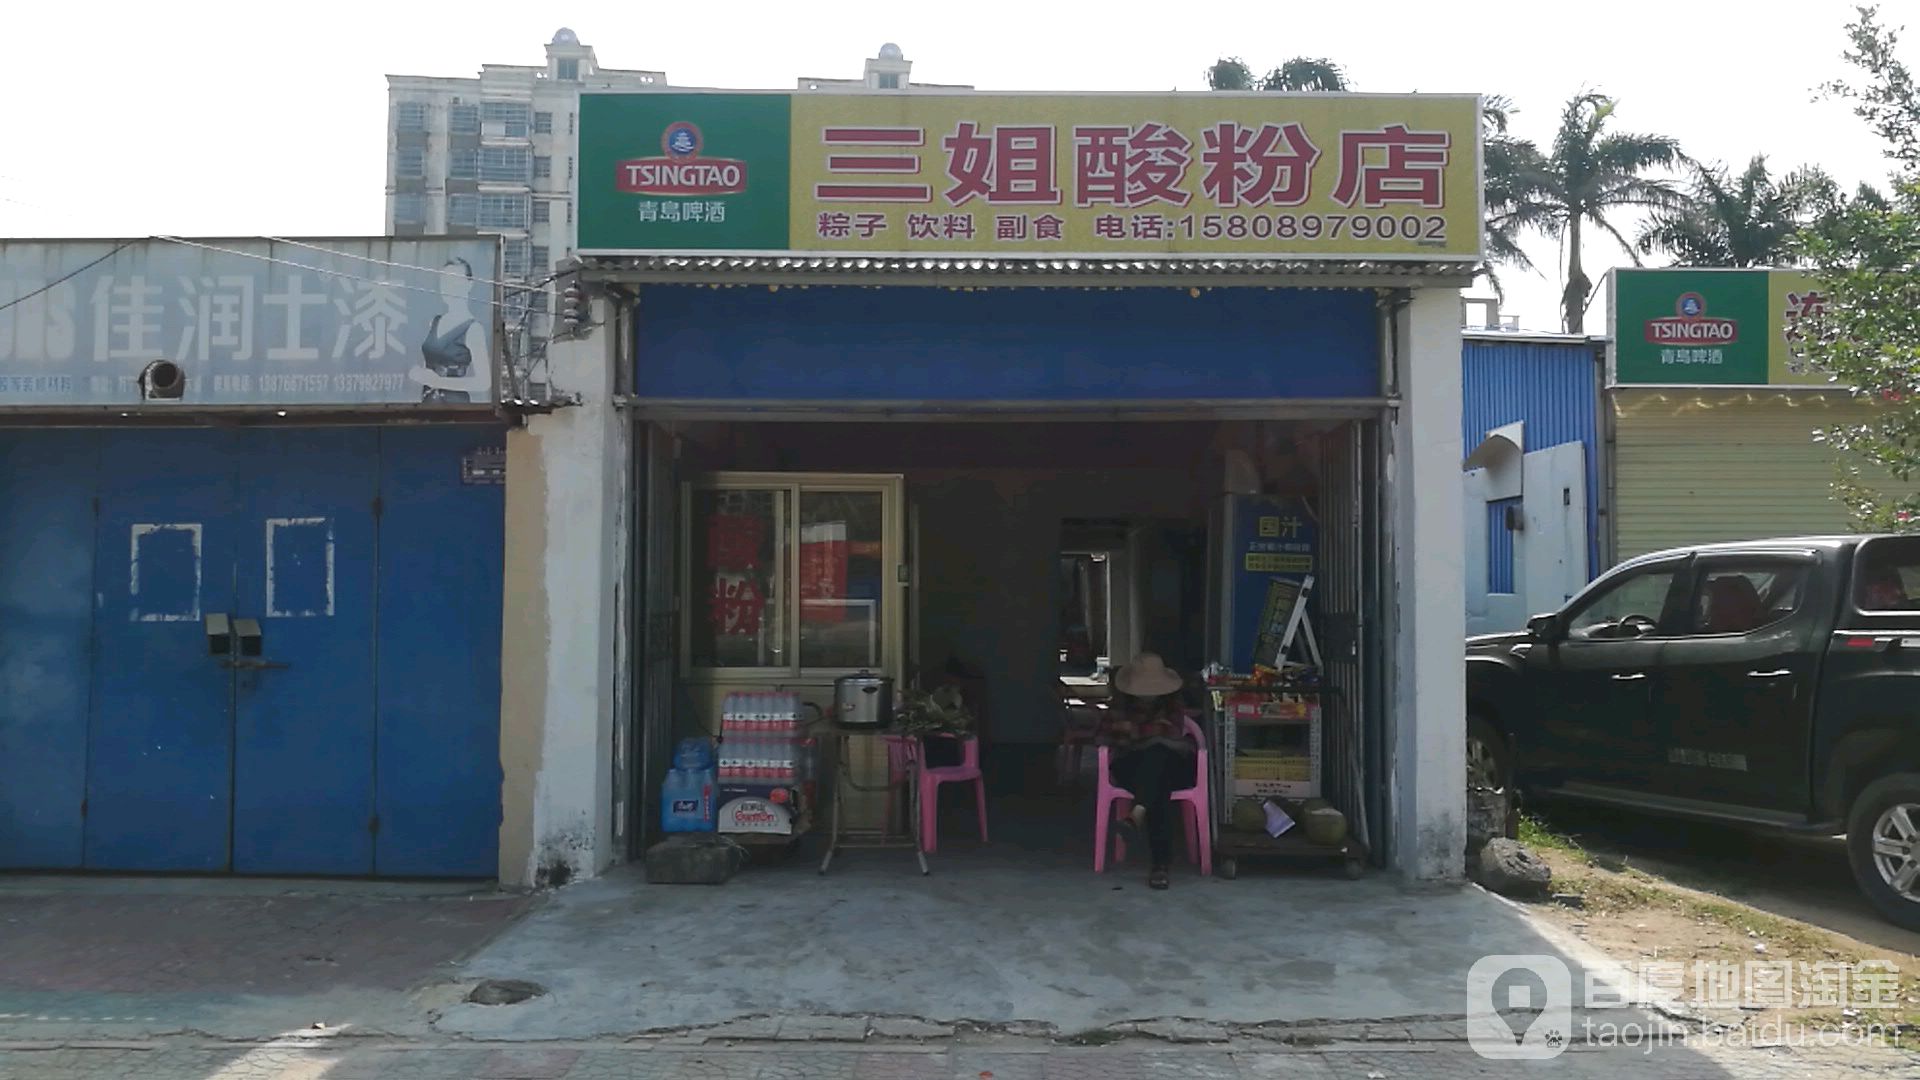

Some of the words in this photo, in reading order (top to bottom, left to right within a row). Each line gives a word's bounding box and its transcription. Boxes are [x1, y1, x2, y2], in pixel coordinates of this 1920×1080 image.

[626, 164, 740, 188] TSINGTAO
[815, 122, 1451, 208] 三姐酸粉店
[638, 201, 726, 223] 青岛啤酒
[818, 213, 887, 239] 粽子
[907, 213, 976, 240] 饮料
[996, 213, 1065, 240] 副食
[89, 274, 410, 361] 佳润士漆
[1651, 322, 1733, 339] TSINGTAO
[1660, 348, 1723, 365] 青岛啤酒
